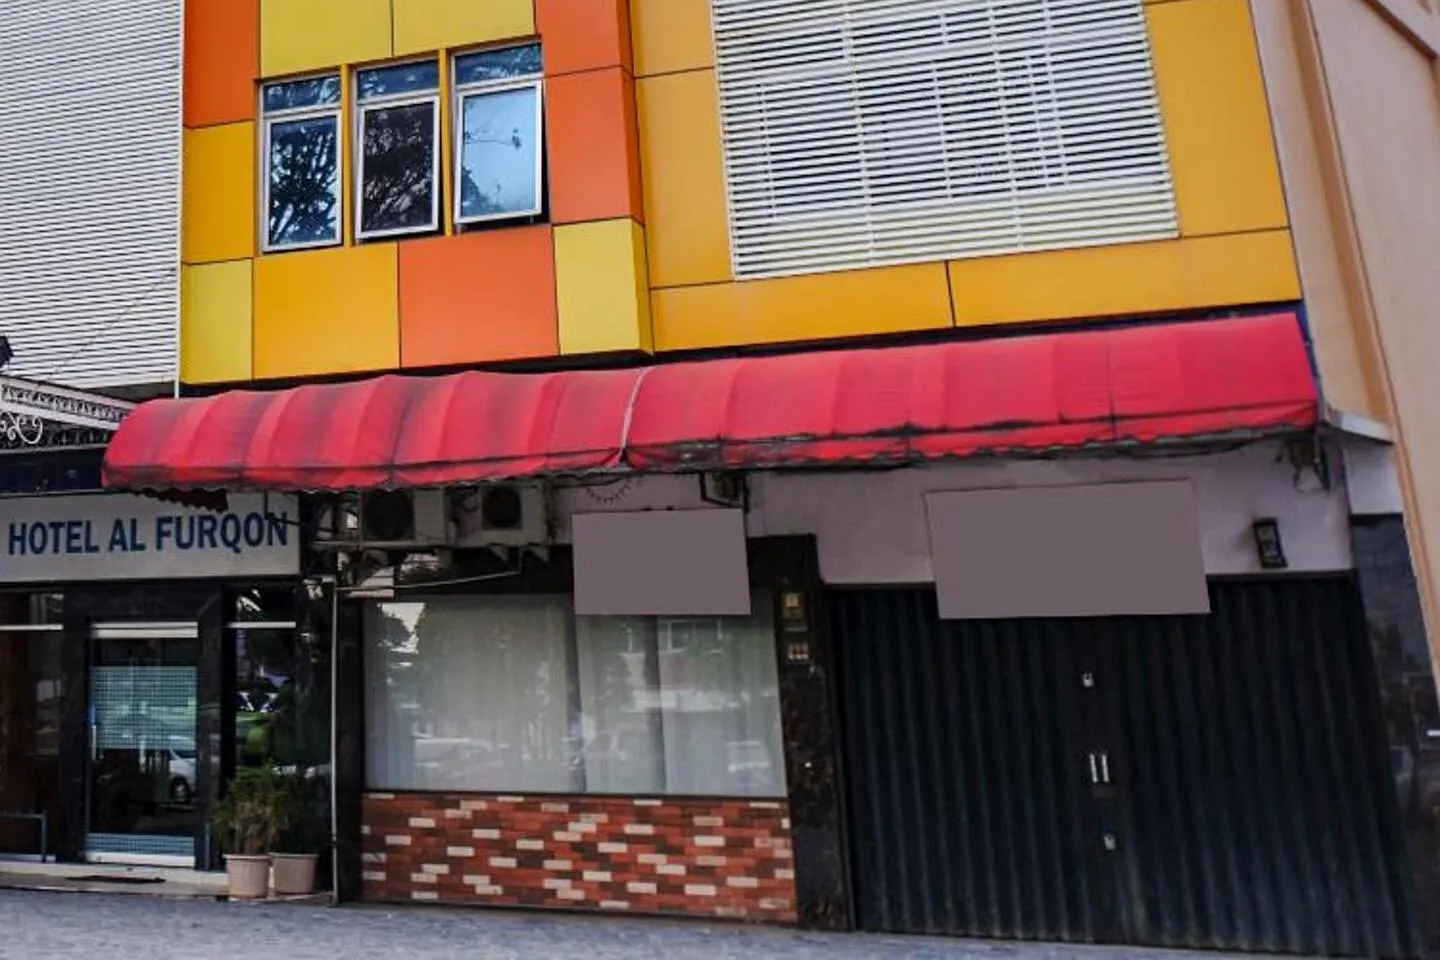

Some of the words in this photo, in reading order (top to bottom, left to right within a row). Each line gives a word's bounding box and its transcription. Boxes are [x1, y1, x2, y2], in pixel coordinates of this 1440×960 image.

[7, 522, 101, 556] HOTEL
[108, 518, 147, 553] AL
[155, 511, 289, 554] FURQON
